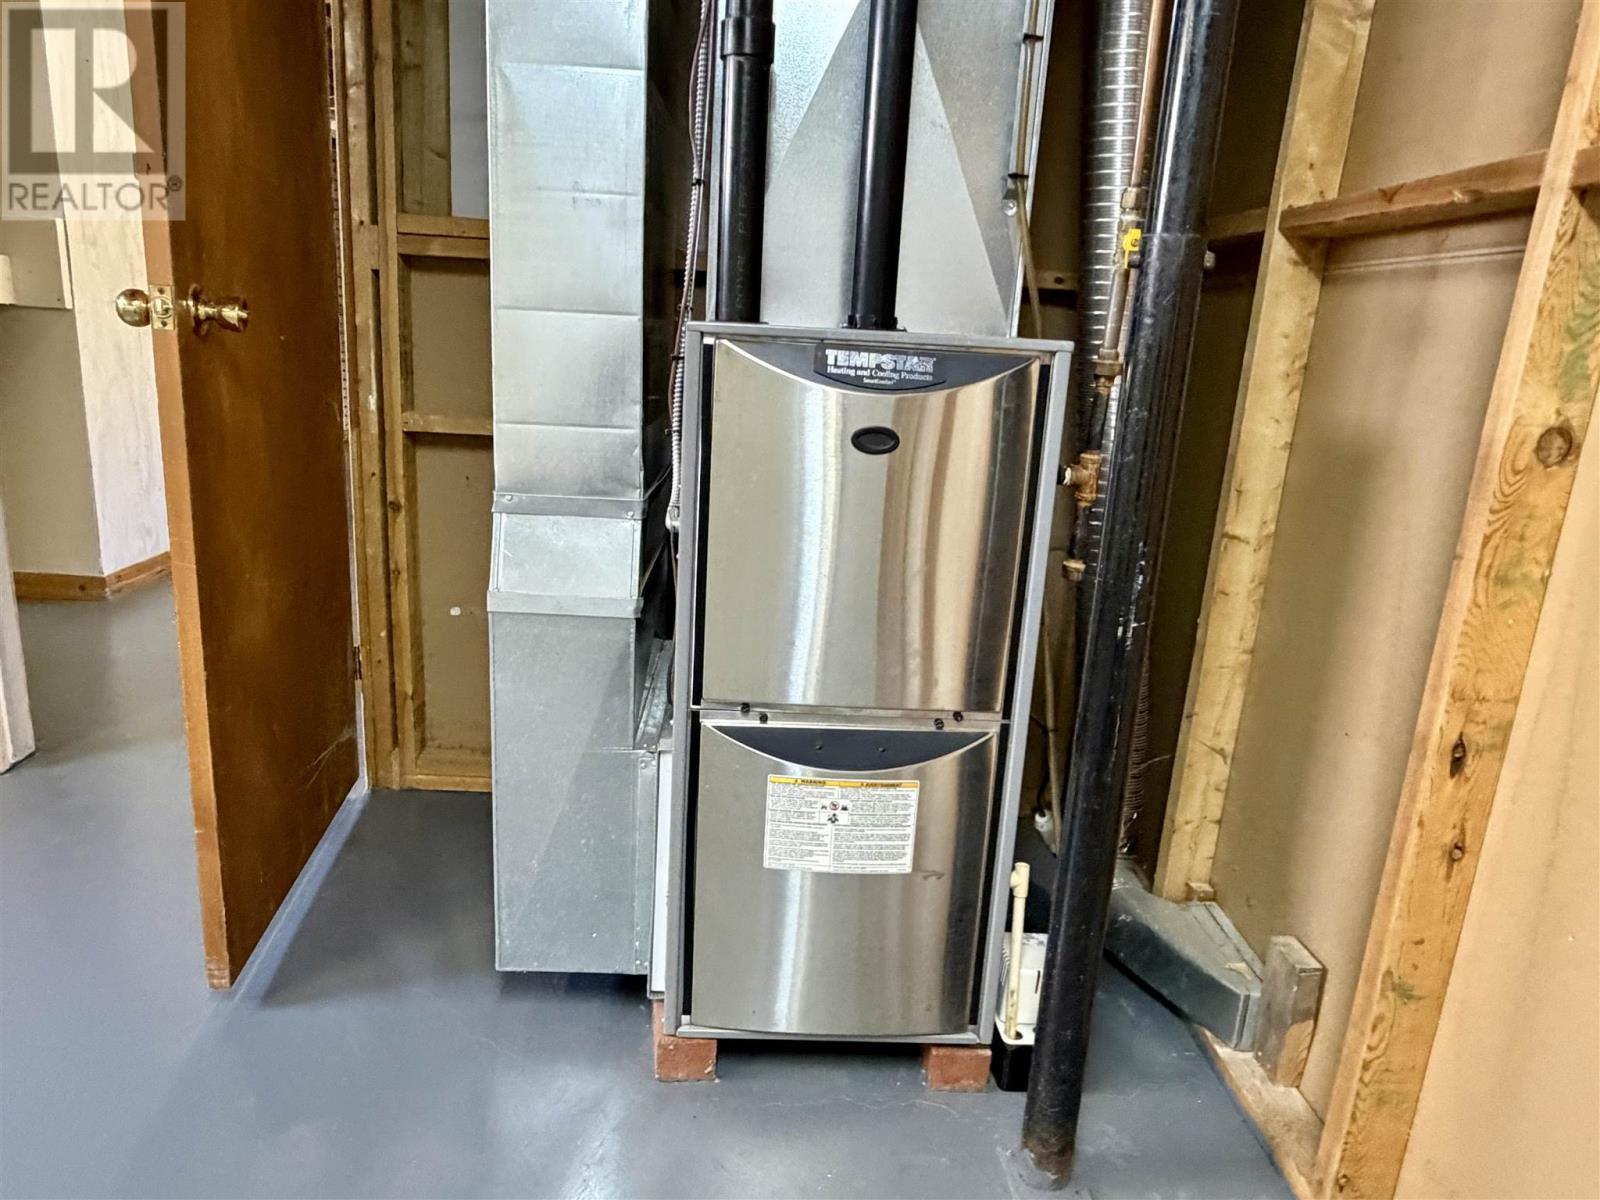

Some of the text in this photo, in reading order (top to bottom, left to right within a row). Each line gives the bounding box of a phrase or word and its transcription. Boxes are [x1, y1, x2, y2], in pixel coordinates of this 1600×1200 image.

[825, 349, 934, 373] TEMPSTAR
[827, 366, 855, 376] Heating
[871, 369, 900, 380] Cooling
[901, 371, 933, 381] Products
